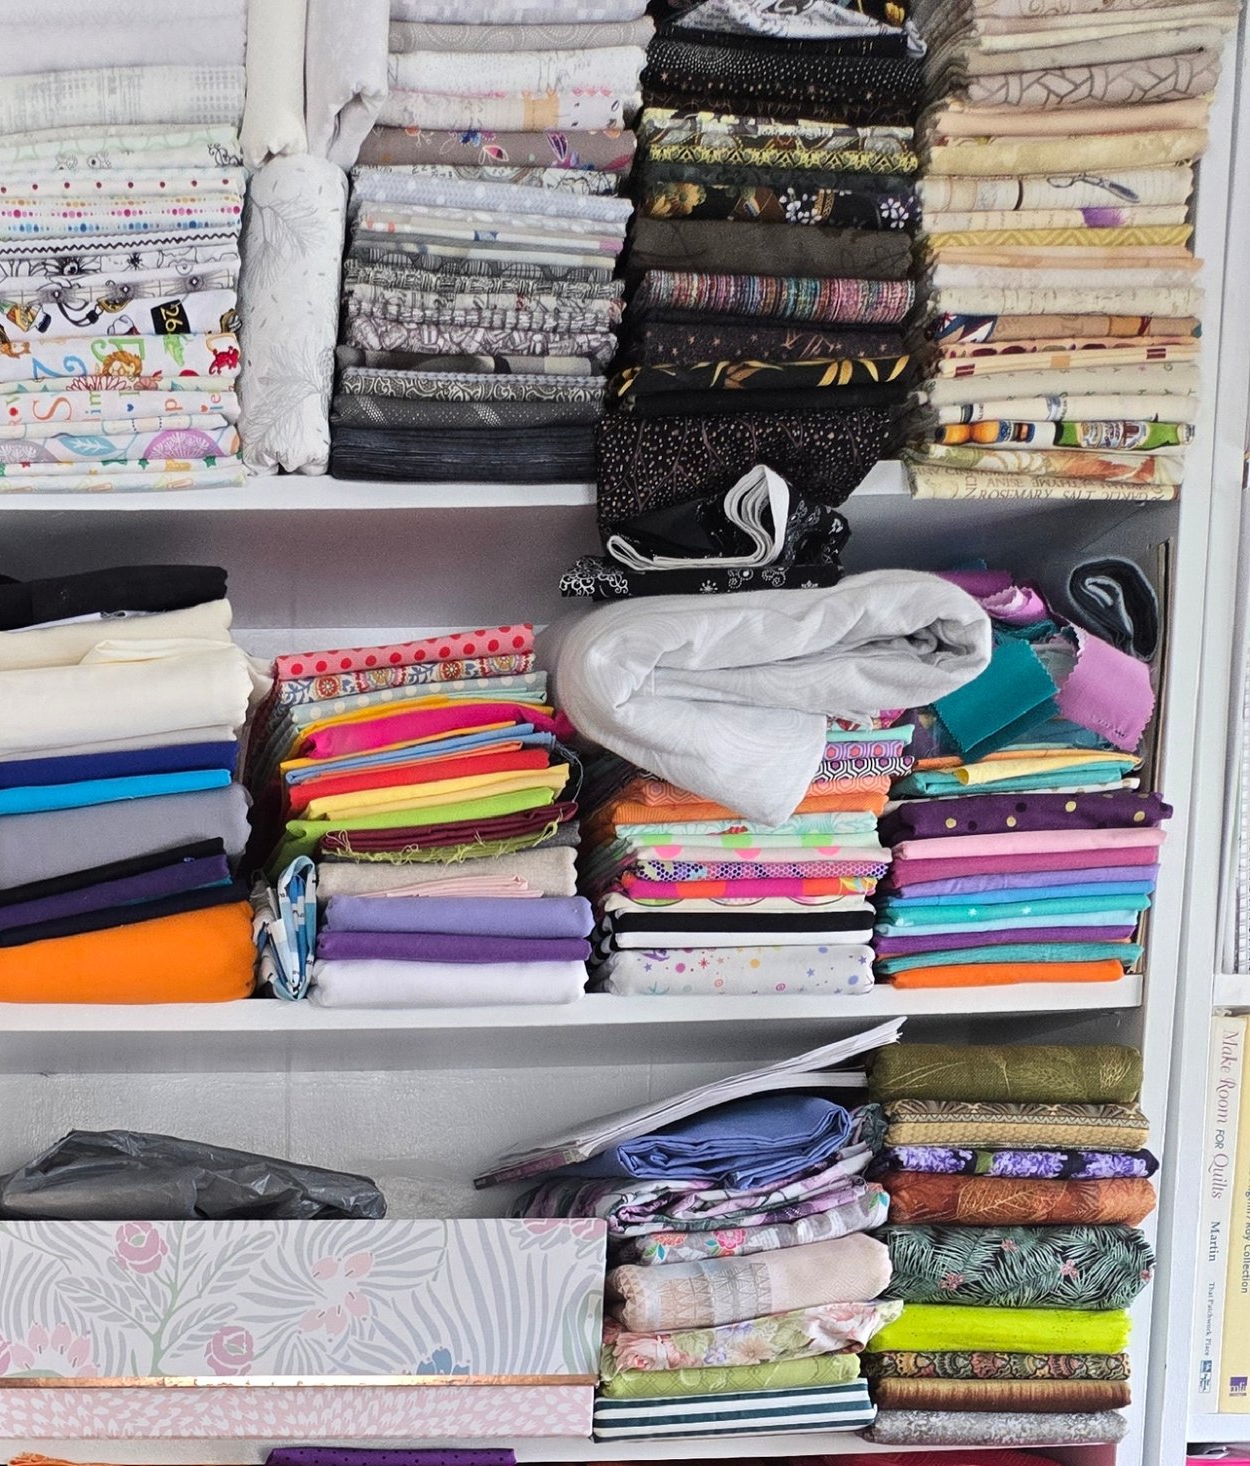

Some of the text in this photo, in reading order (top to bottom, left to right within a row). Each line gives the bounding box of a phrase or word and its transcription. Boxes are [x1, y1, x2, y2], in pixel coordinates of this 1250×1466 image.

[978, 488, 1053, 500] ROSEMARY
[1208, 1028, 1239, 1200] Make Room FOR Quilts
[1208, 1221, 1221, 1262] Martin
